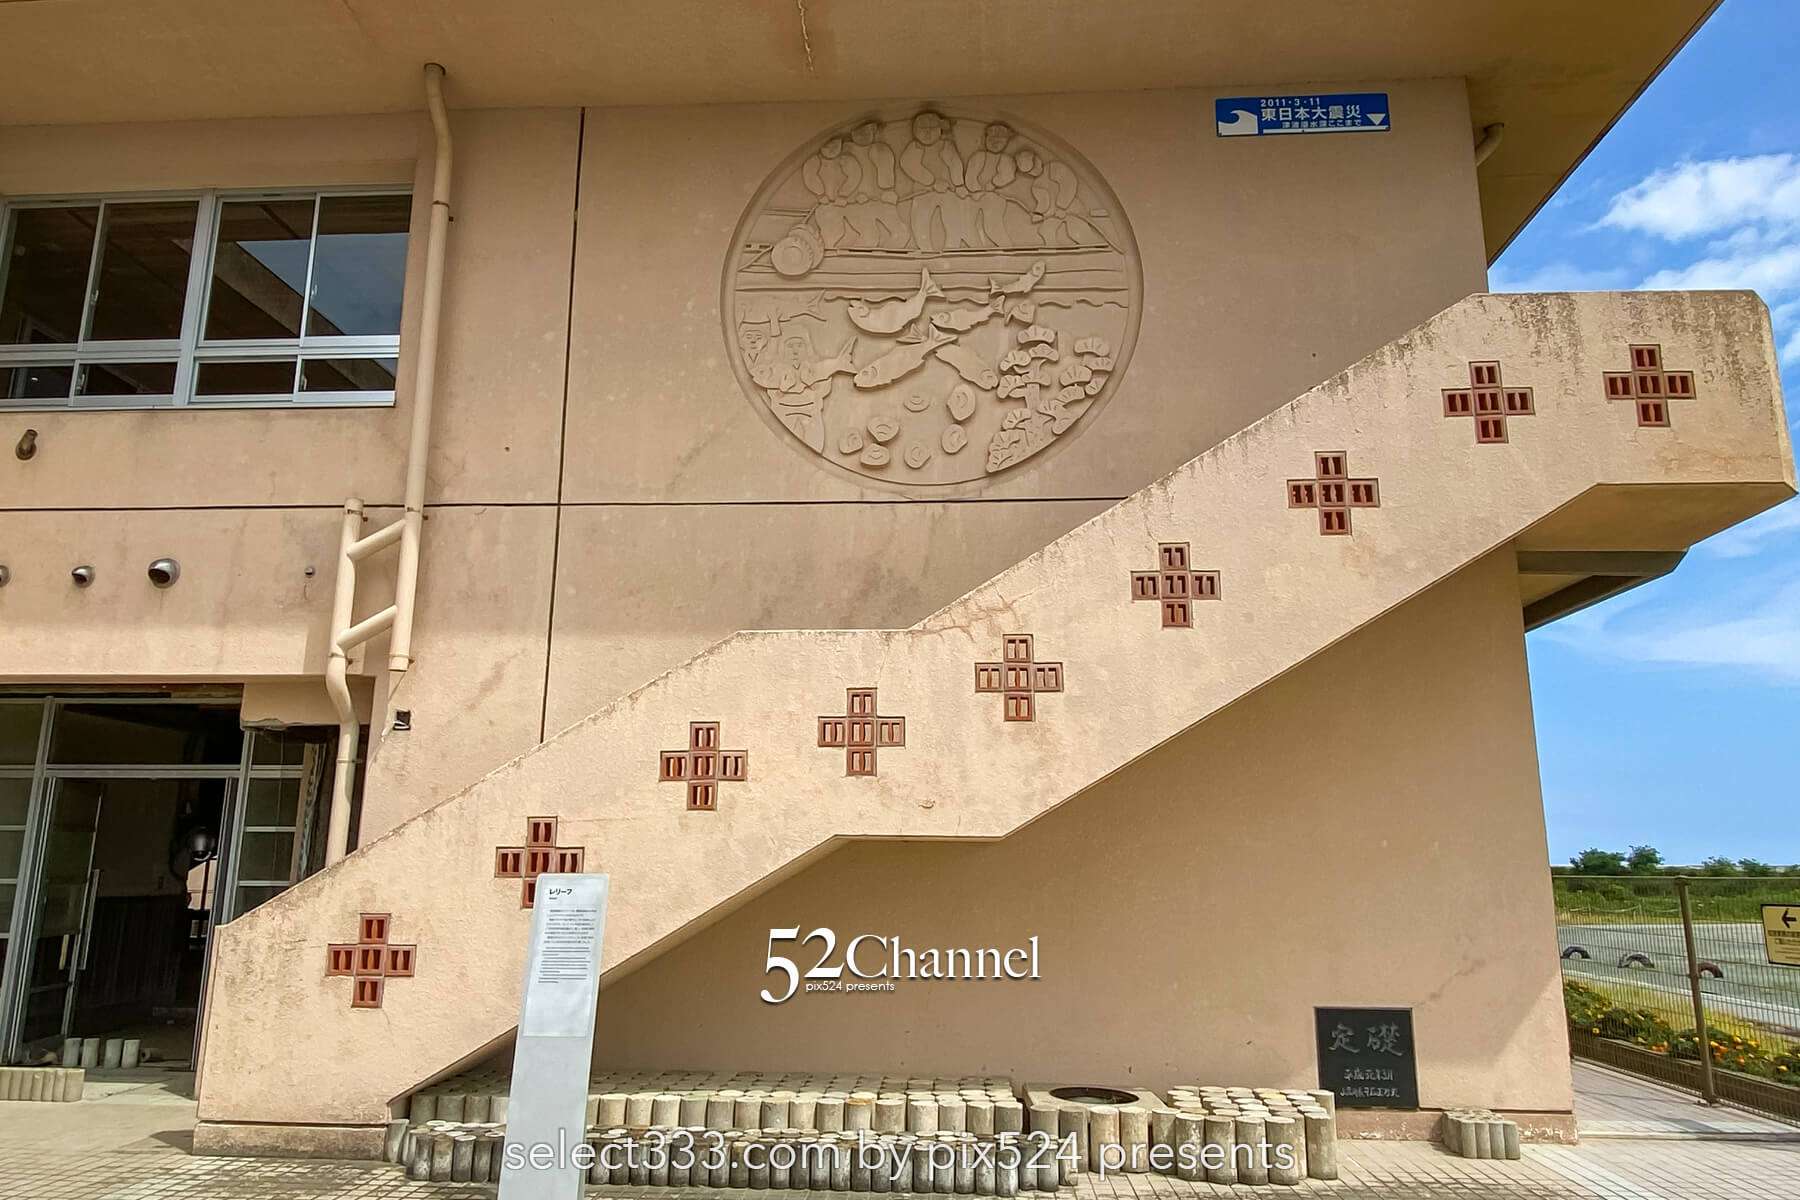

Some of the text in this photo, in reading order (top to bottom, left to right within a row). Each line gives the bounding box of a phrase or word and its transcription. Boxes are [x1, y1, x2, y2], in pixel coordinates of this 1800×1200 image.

[1261, 105, 1361, 121] 東日本大震災
[1328, 1022, 1402, 1056] 定礎
